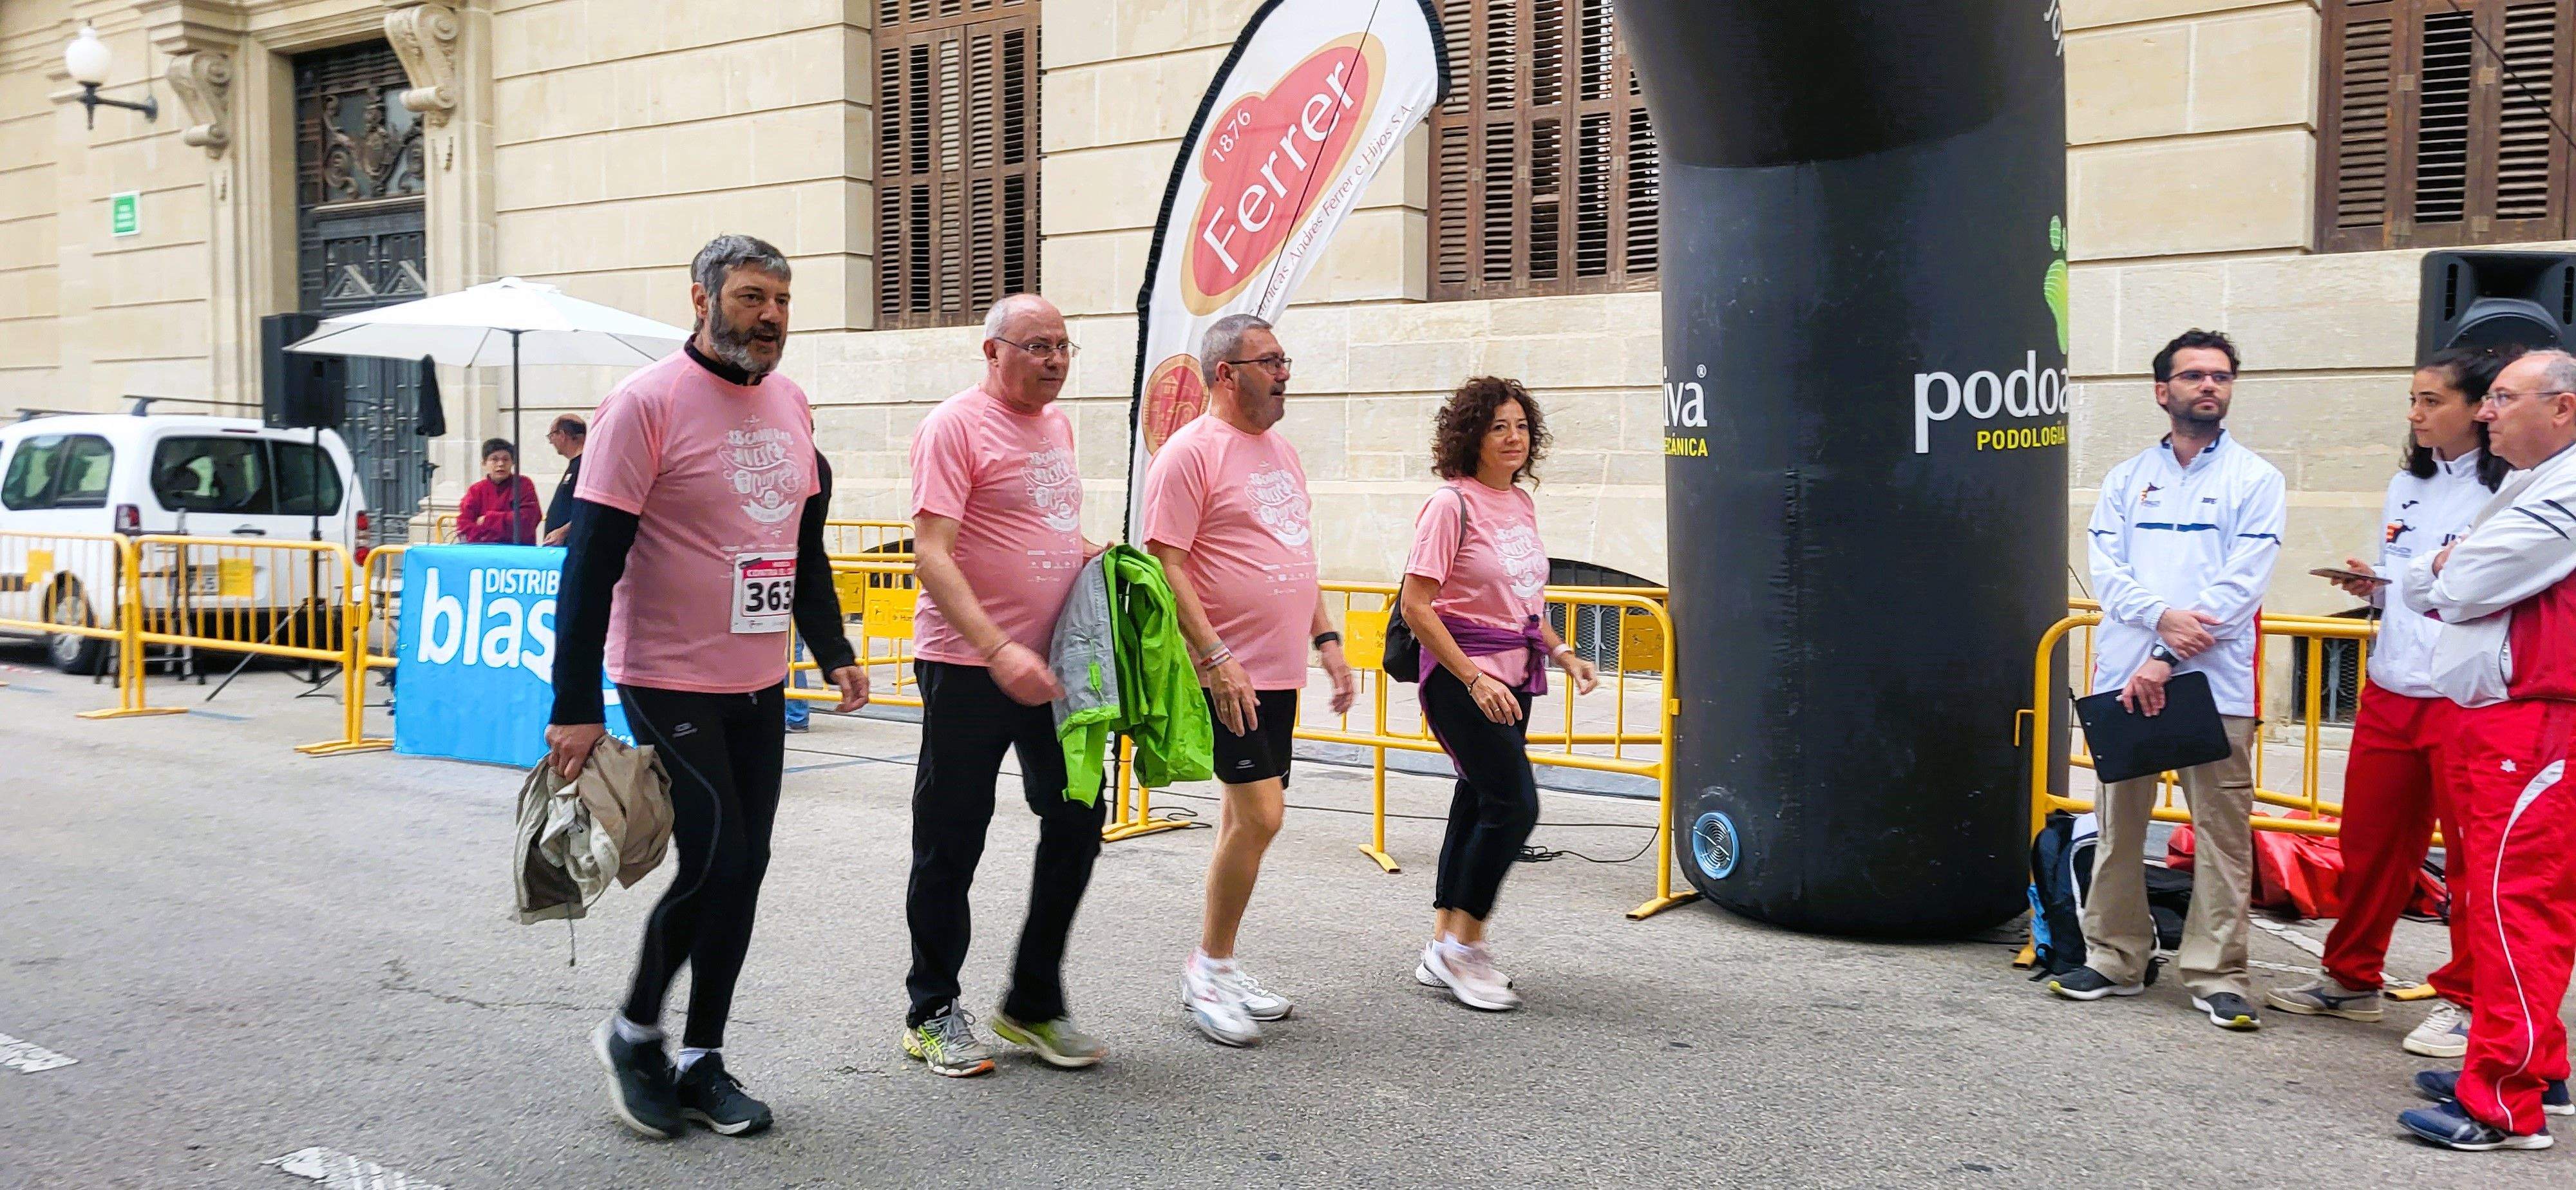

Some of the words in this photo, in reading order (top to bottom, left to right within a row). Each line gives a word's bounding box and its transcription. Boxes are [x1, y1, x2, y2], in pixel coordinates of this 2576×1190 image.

[1202, 61, 1355, 275] Ferrer
[1211, 108, 1251, 163] 1876
[1322, 176, 1354, 217] Ferrer
[1362, 129, 1392, 165] Hijos
